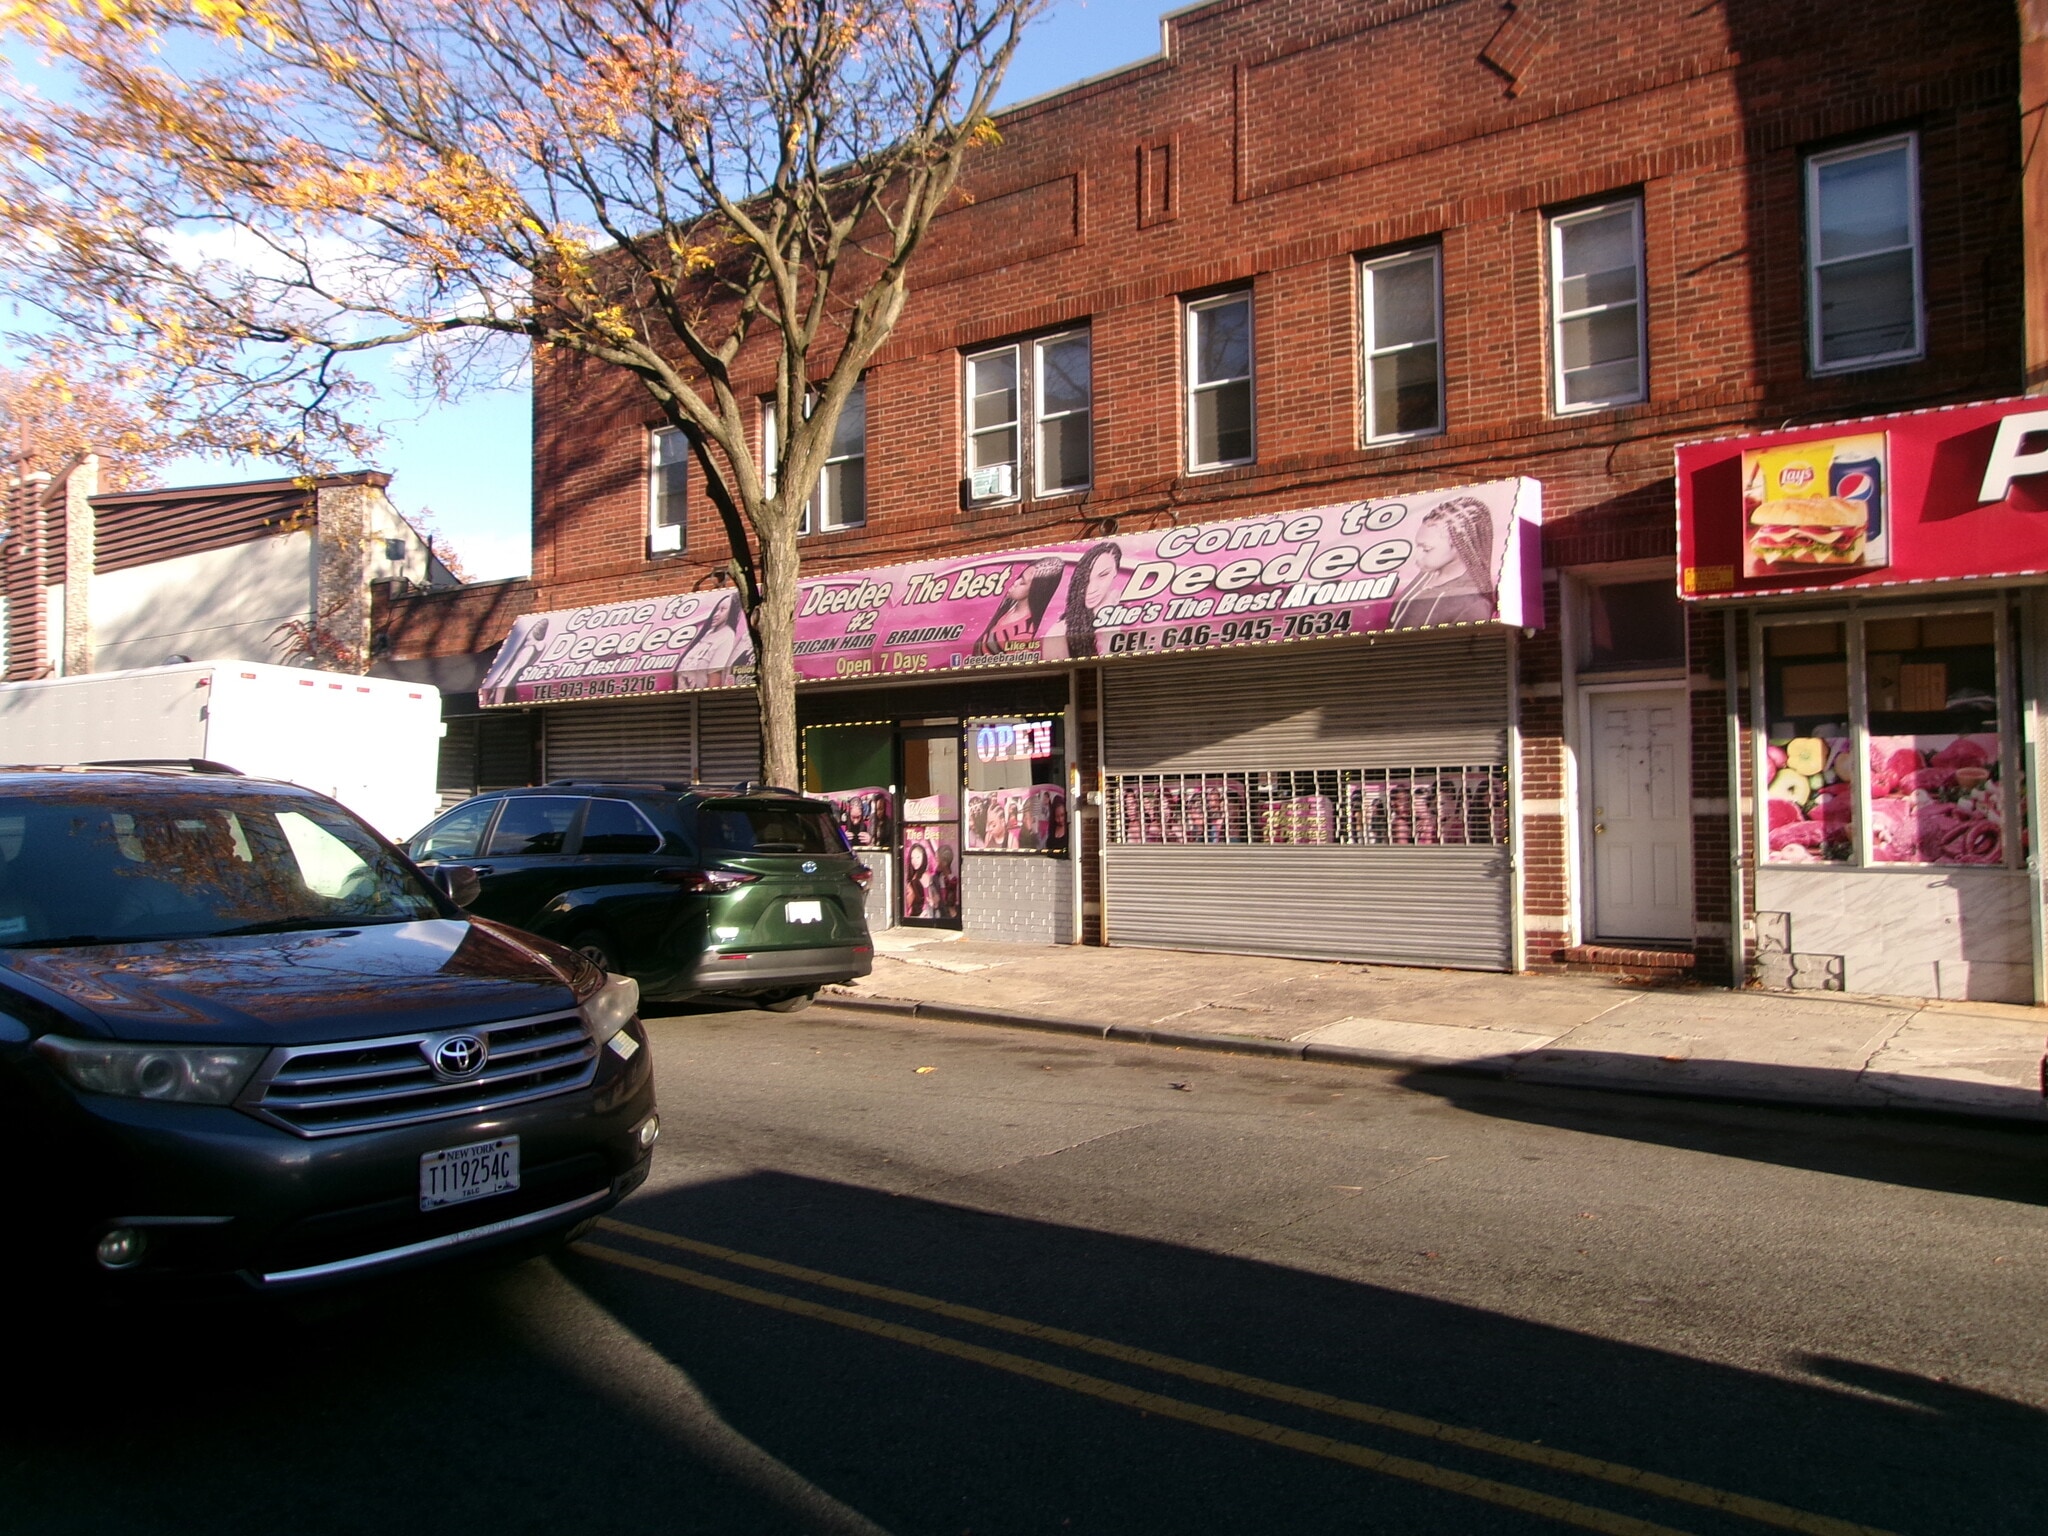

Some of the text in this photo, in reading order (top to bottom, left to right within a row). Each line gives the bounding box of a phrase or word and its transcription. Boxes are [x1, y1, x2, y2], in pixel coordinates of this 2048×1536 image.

[1156, 501, 1407, 560] Come to
[1119, 539, 1413, 602] Deedee
[800, 565, 1013, 617] Deedee The Best
[1093, 573, 1398, 628] She's The Best Around
[566, 596, 700, 632] Come to
[846, 611, 878, 633] #2
[541, 624, 699, 663] Deedee
[839, 633, 877, 649] HAIR
[884, 625, 964, 646] BRAIDING
[1004, 640, 1040, 652] Like us
[1110, 610, 1351, 654] CEL: 646-945-7634
[519, 653, 680, 682] She's The Best in Town
[836, 652, 928, 676] Open 7 Days
[964, 651, 1039, 666] deedeebraiding
[533, 677, 656, 700] TEL: 973-846-3216
[977, 721, 1052, 763] OPEN
[906, 829, 922, 840] The
[447, 1143, 495, 1161] NEW YORK
[430, 1152, 509, 1195] T119254C
